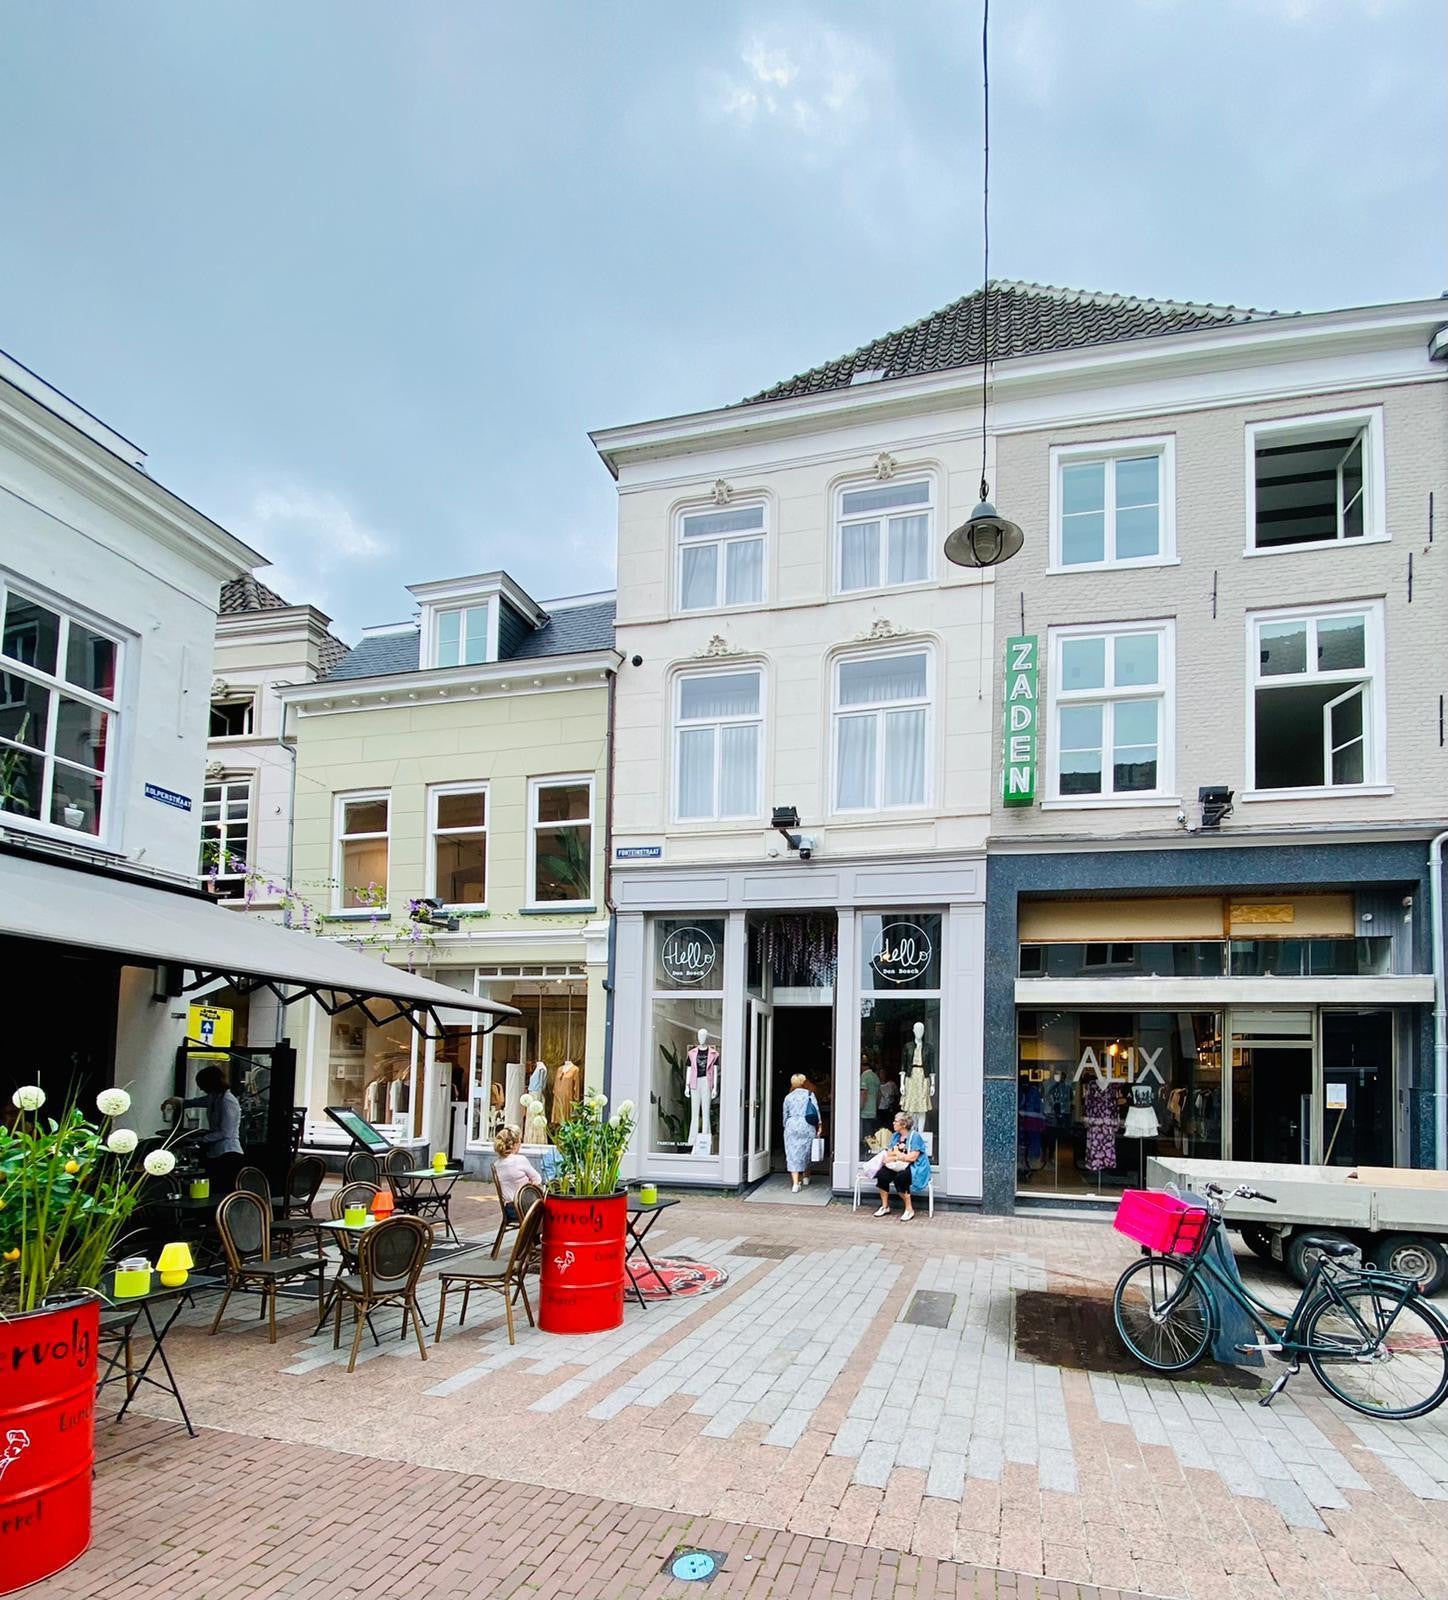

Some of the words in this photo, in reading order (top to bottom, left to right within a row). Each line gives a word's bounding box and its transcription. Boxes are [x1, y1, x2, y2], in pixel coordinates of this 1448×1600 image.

[1009, 643, 1033, 793] ZADEN
[664, 941, 714, 969] Hello
[1073, 1046, 1165, 1085] ALIX
